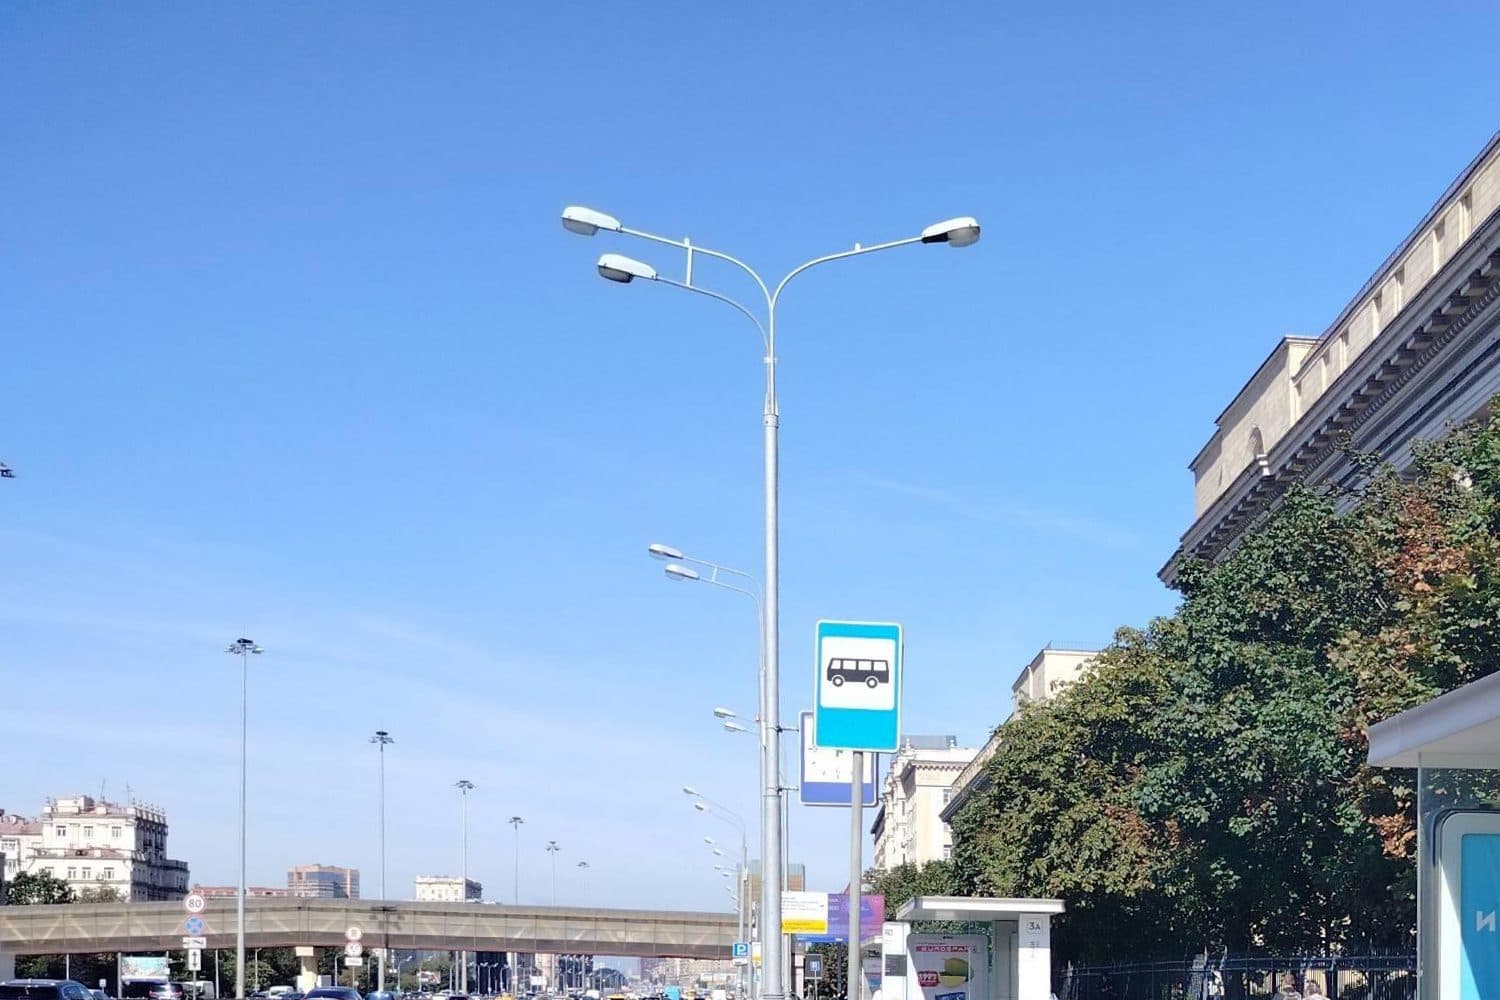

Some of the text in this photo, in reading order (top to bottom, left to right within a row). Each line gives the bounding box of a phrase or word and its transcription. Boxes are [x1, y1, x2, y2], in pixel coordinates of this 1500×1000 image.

[188, 898, 201, 908] 80
[1475, 911, 1496, 932] И
[737, 944, 746, 956] P
